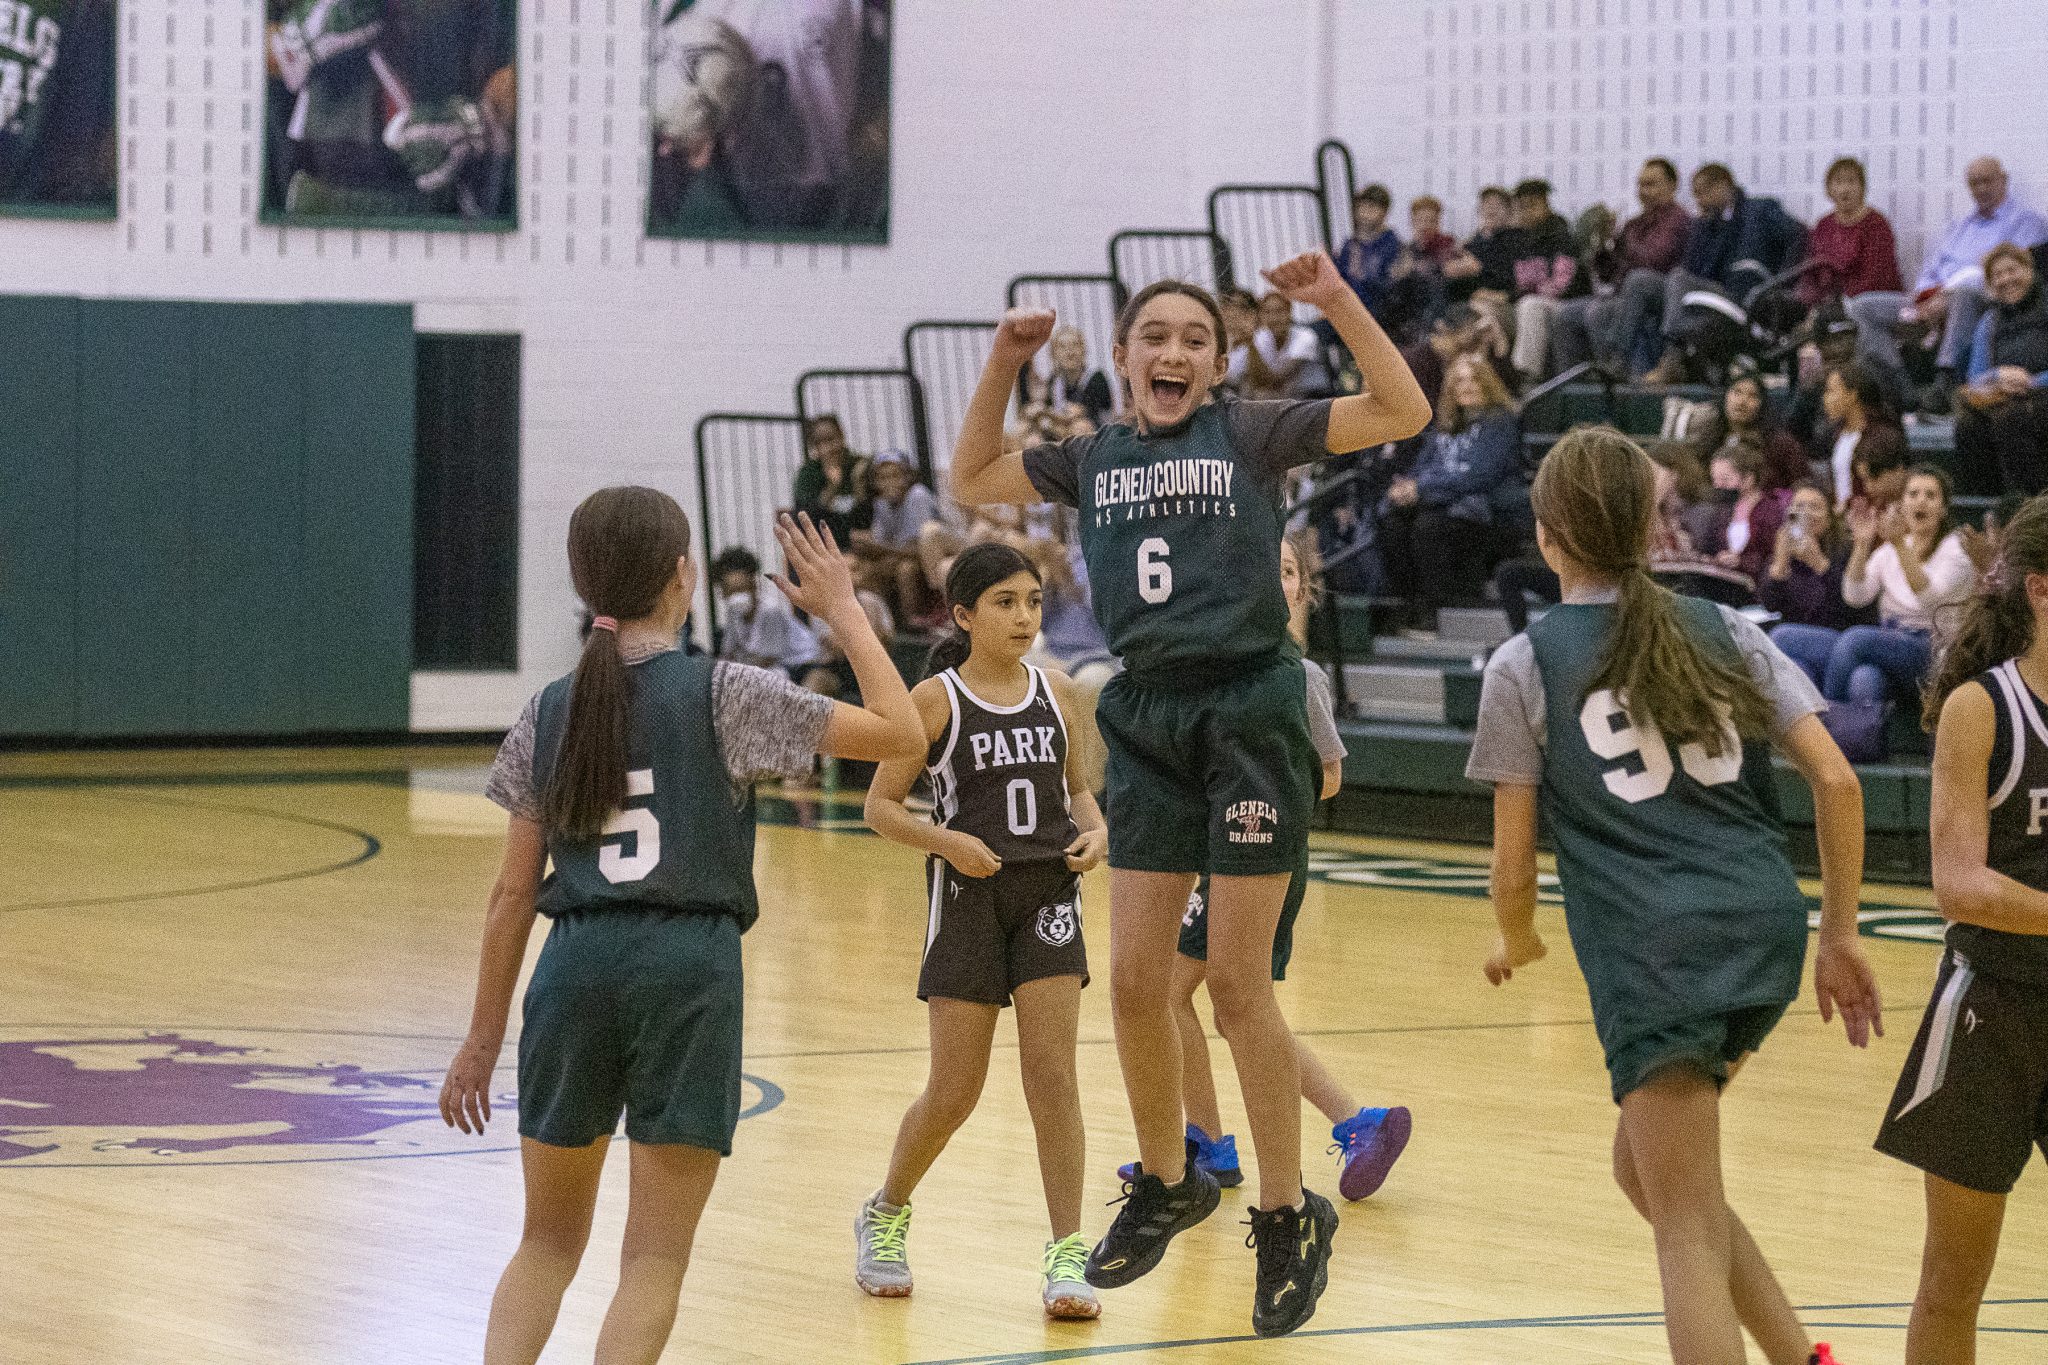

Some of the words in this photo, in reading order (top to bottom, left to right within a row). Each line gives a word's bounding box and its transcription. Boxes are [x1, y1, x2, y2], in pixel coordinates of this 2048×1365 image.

[1095, 464, 1153, 508] GLENELG
[1154, 458, 1234, 498] COUNTRY
[1127, 500, 1236, 521] ATHLETICS
[1137, 537, 1173, 604] 6
[969, 726, 1056, 771] PARK
[599, 768, 660, 884] 5
[1006, 778, 1036, 835] 0
[1225, 800, 1278, 825] GLENELG
[1229, 831, 1273, 843] DRAGONS
